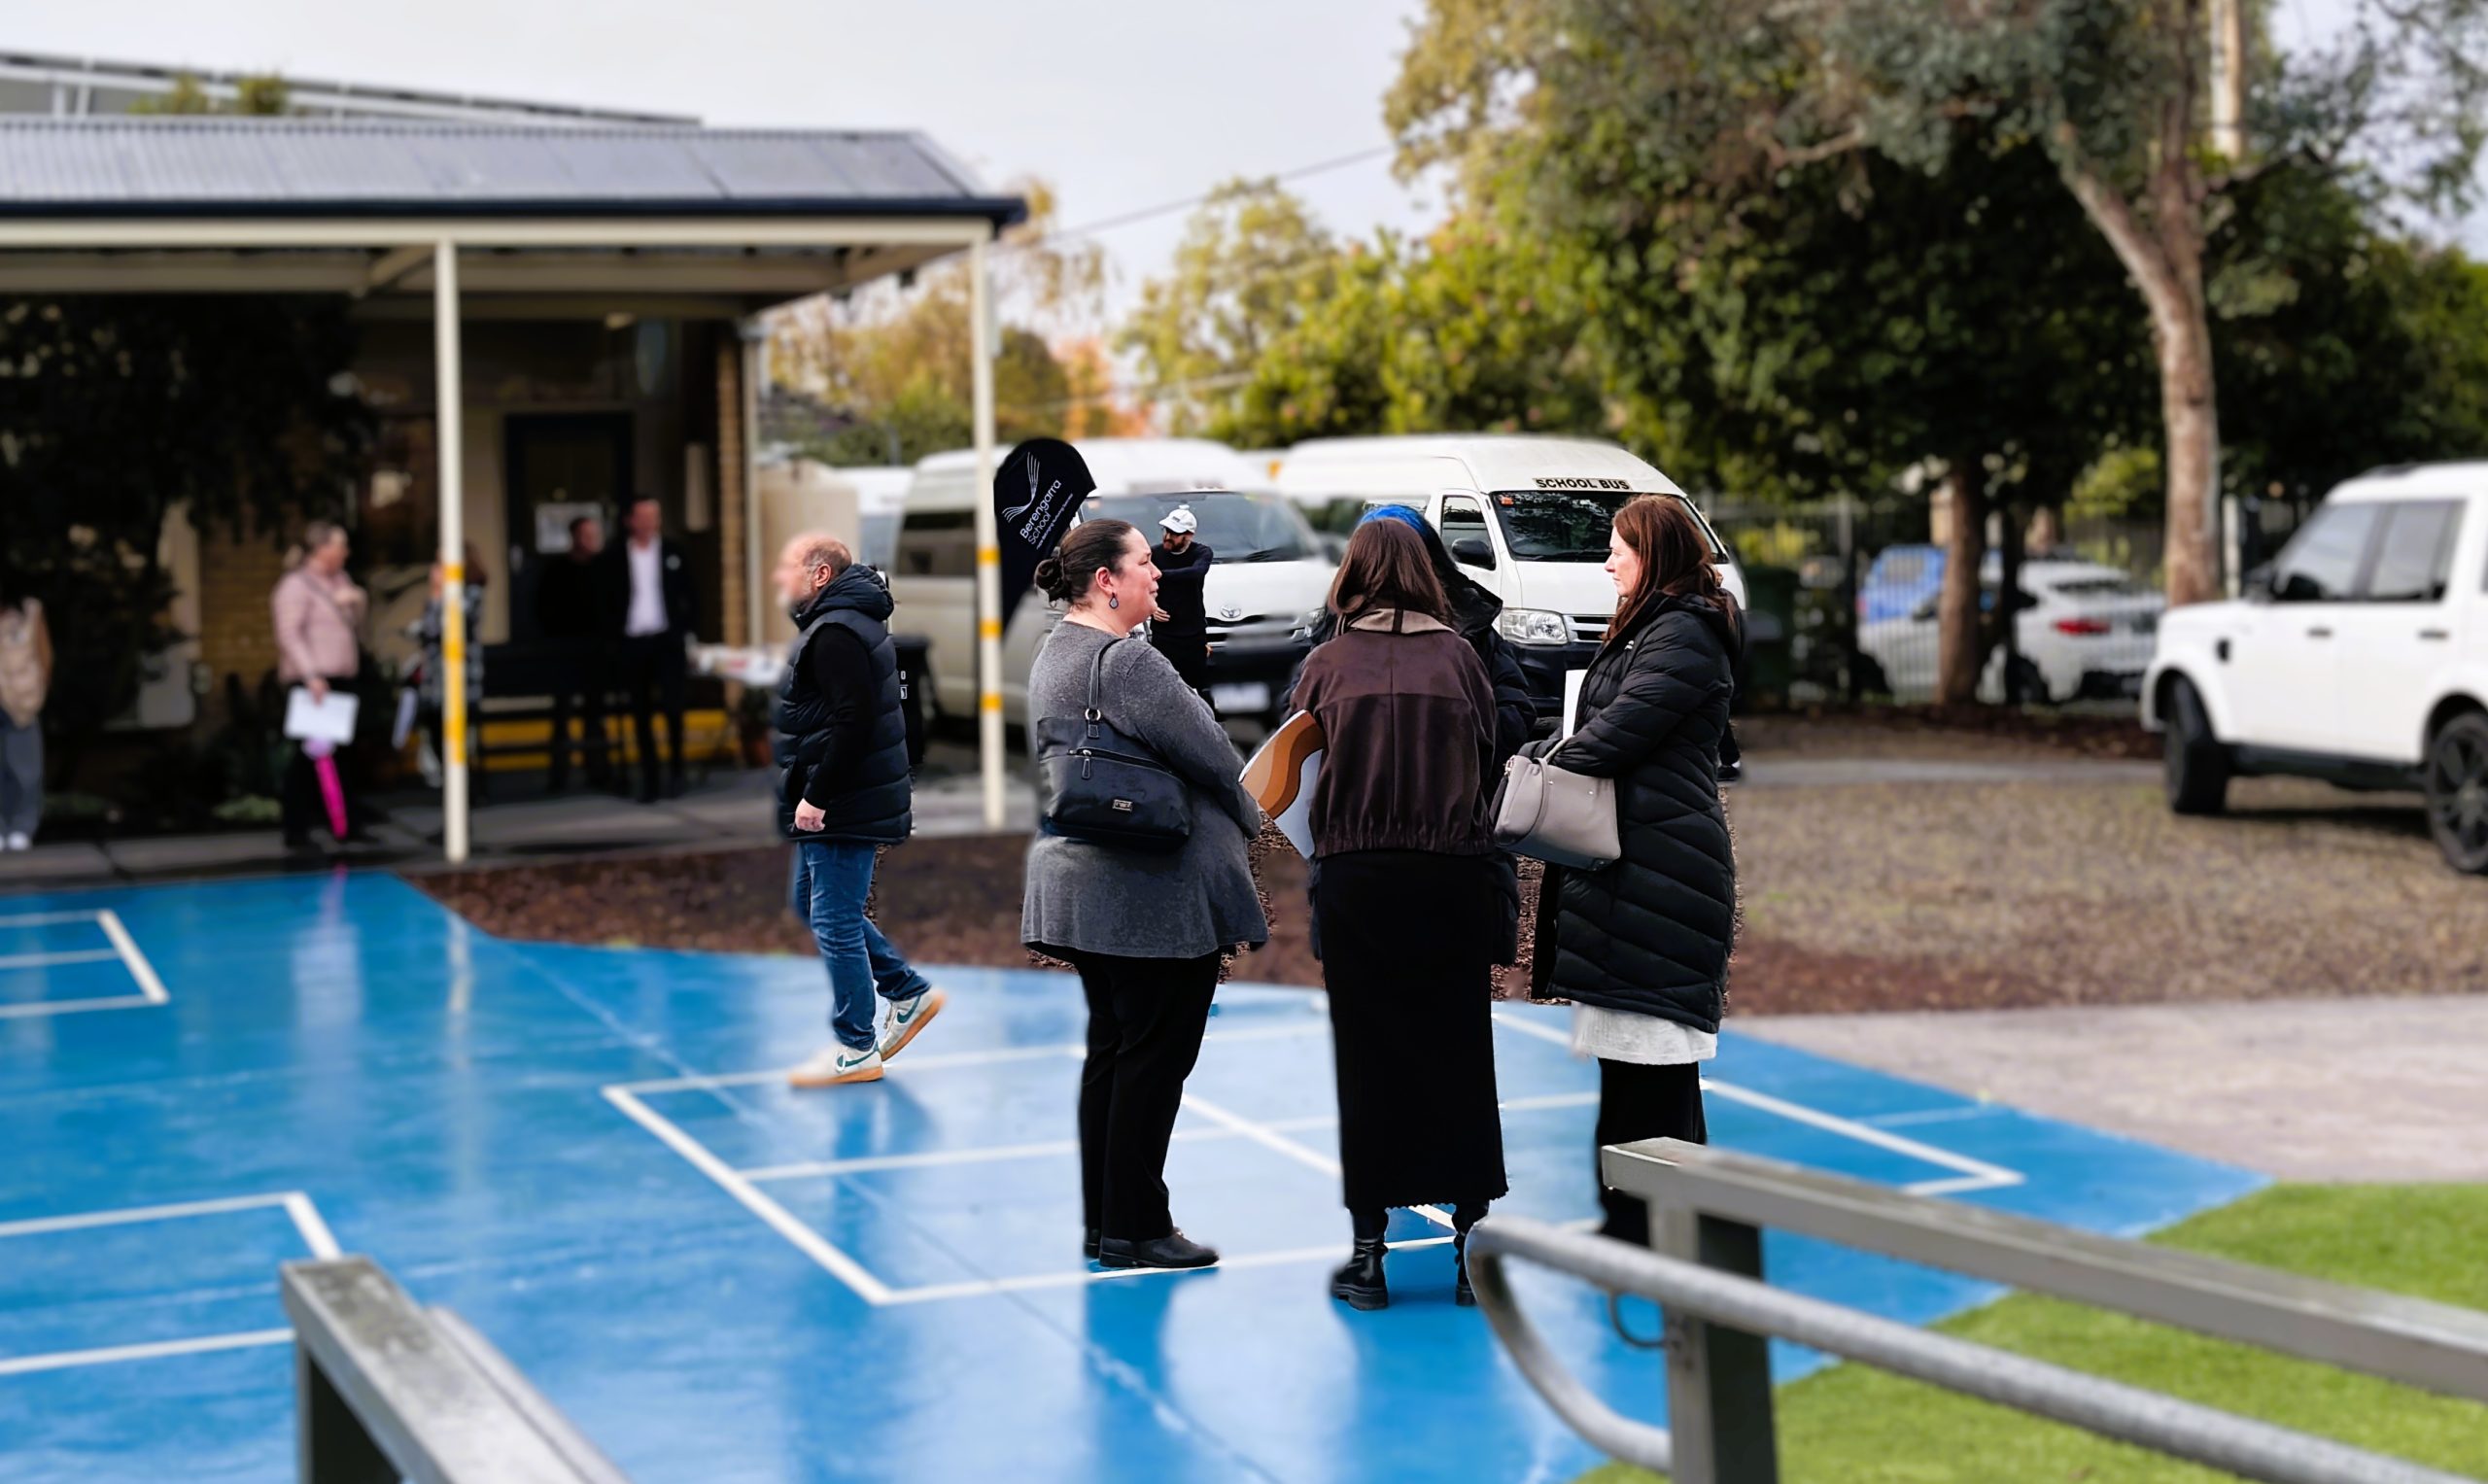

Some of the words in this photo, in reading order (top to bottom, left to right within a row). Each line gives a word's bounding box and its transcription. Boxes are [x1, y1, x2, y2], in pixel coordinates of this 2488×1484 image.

[1536, 478, 1598, 489] SCHOOL
[1599, 479, 1630, 490] BUS
[1019, 479, 1062, 539] Berengarra
[1027, 510, 1052, 545] School
